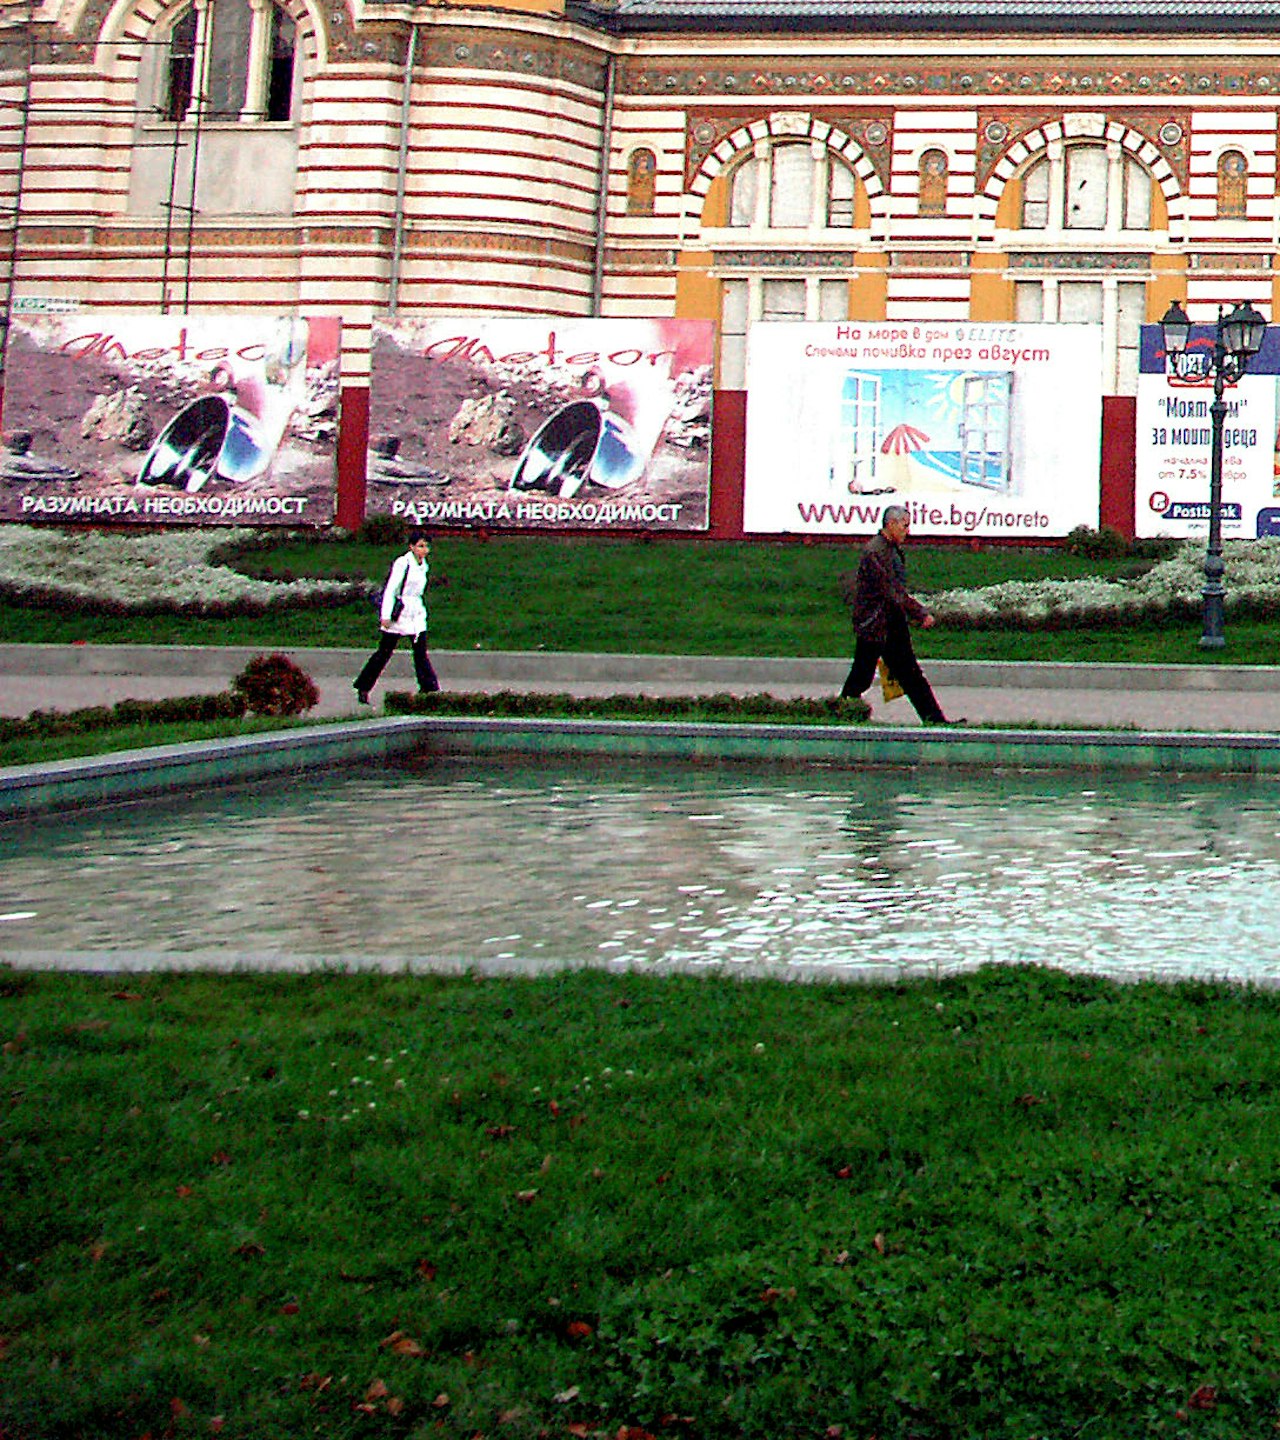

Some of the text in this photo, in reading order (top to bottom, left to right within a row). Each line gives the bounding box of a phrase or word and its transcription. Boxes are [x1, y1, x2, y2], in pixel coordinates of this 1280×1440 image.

[59, 328, 266, 361] Meteo
[837, 326, 1018, 343] На море в дом ELITE
[805, 344, 1050, 365] Спечели почивка през август
[1152, 428, 1257, 449] за моит деца
[21, 496, 308, 515] РАЗУМНАТА НЕОБХОДИМОСТ
[392, 501, 683, 522] РАЗУМНАТА НЕОБХОДИМОСТ
[1173, 504, 1237, 519] Postbnk
[798, 501, 1049, 532] wwwlite.bg/moreto
